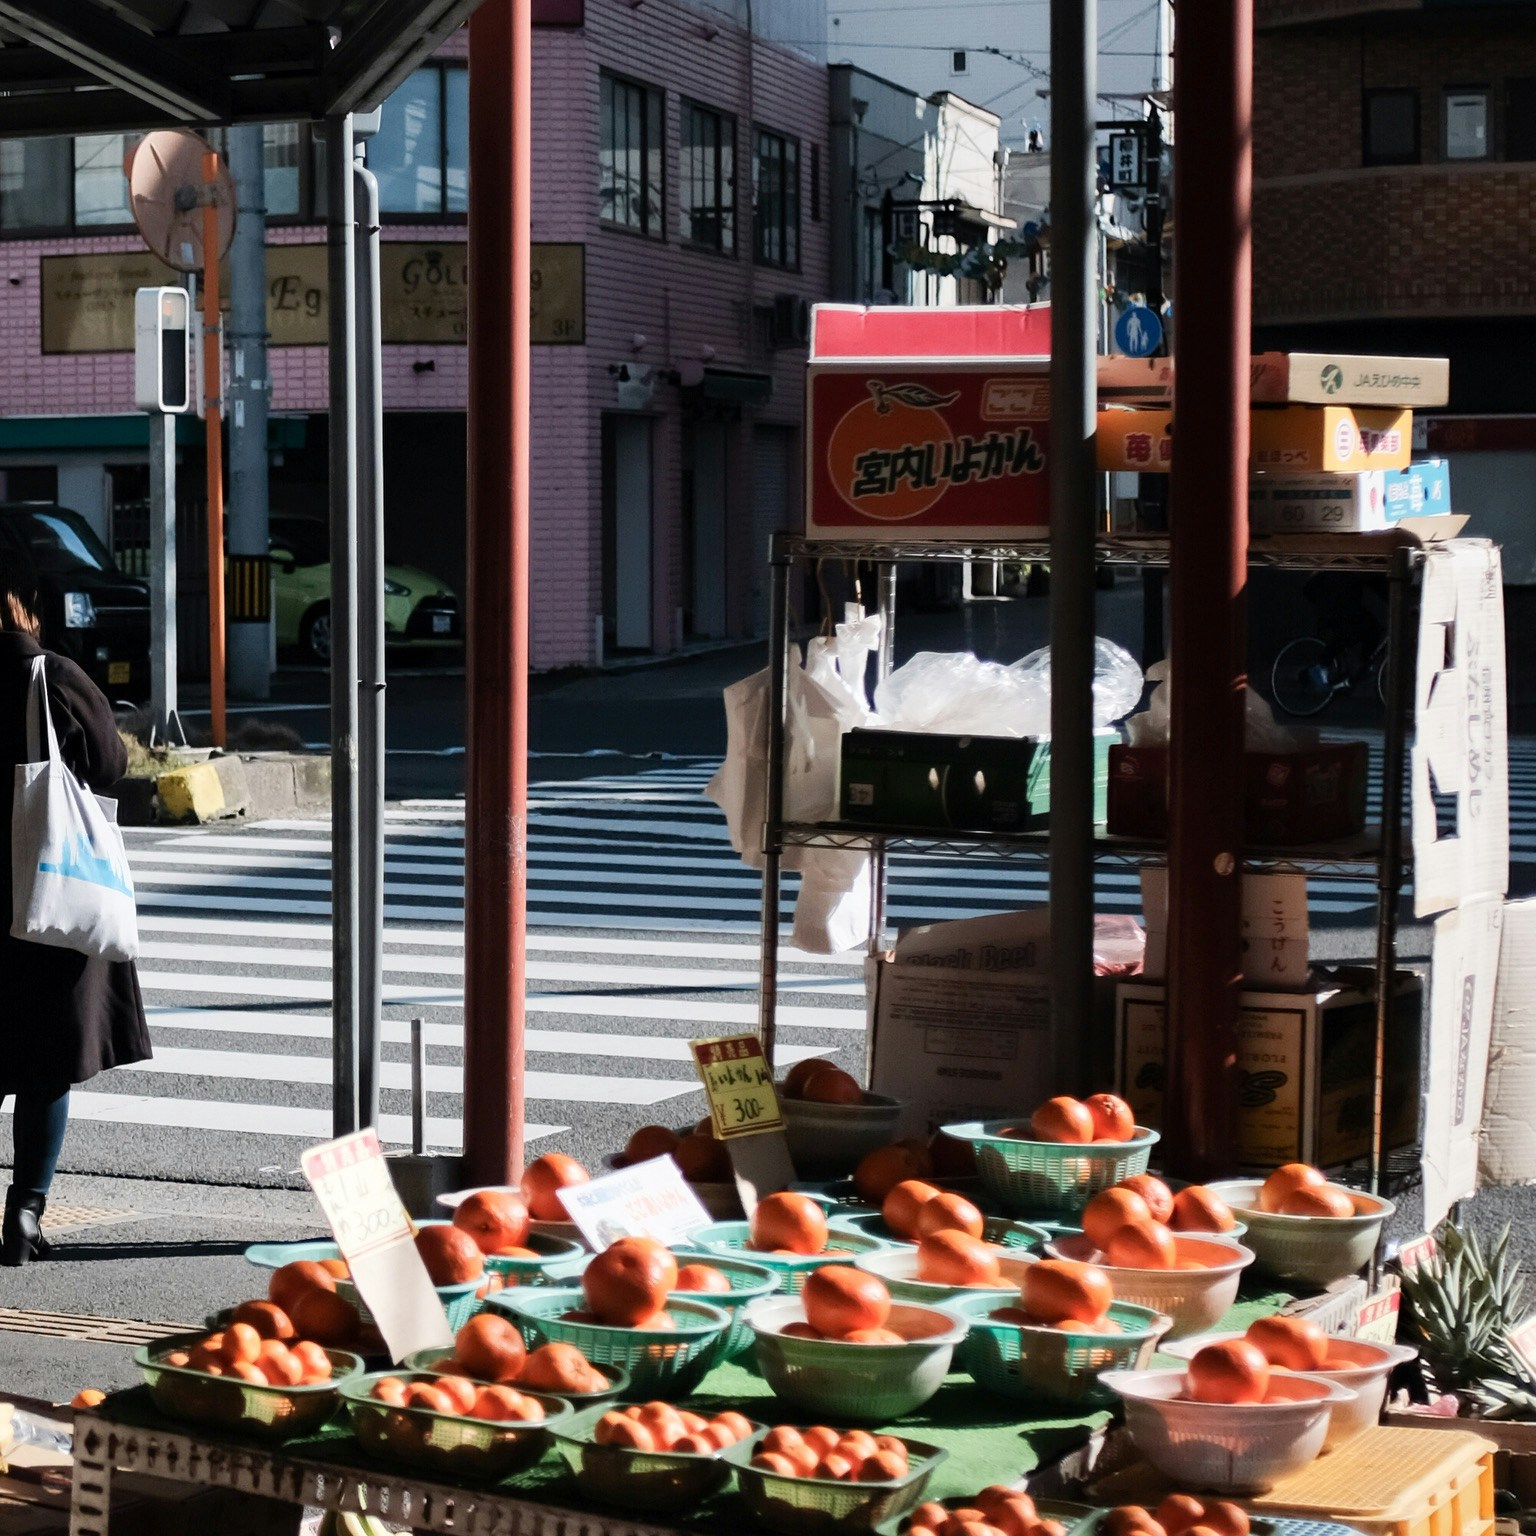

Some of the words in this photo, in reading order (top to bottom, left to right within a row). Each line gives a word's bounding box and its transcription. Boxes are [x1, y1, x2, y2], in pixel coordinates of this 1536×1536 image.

[851, 426, 1046, 500] 宮内いよかん
[1322, 506, 1344, 522] 29
[1270, 900, 1287, 973] こうげん
